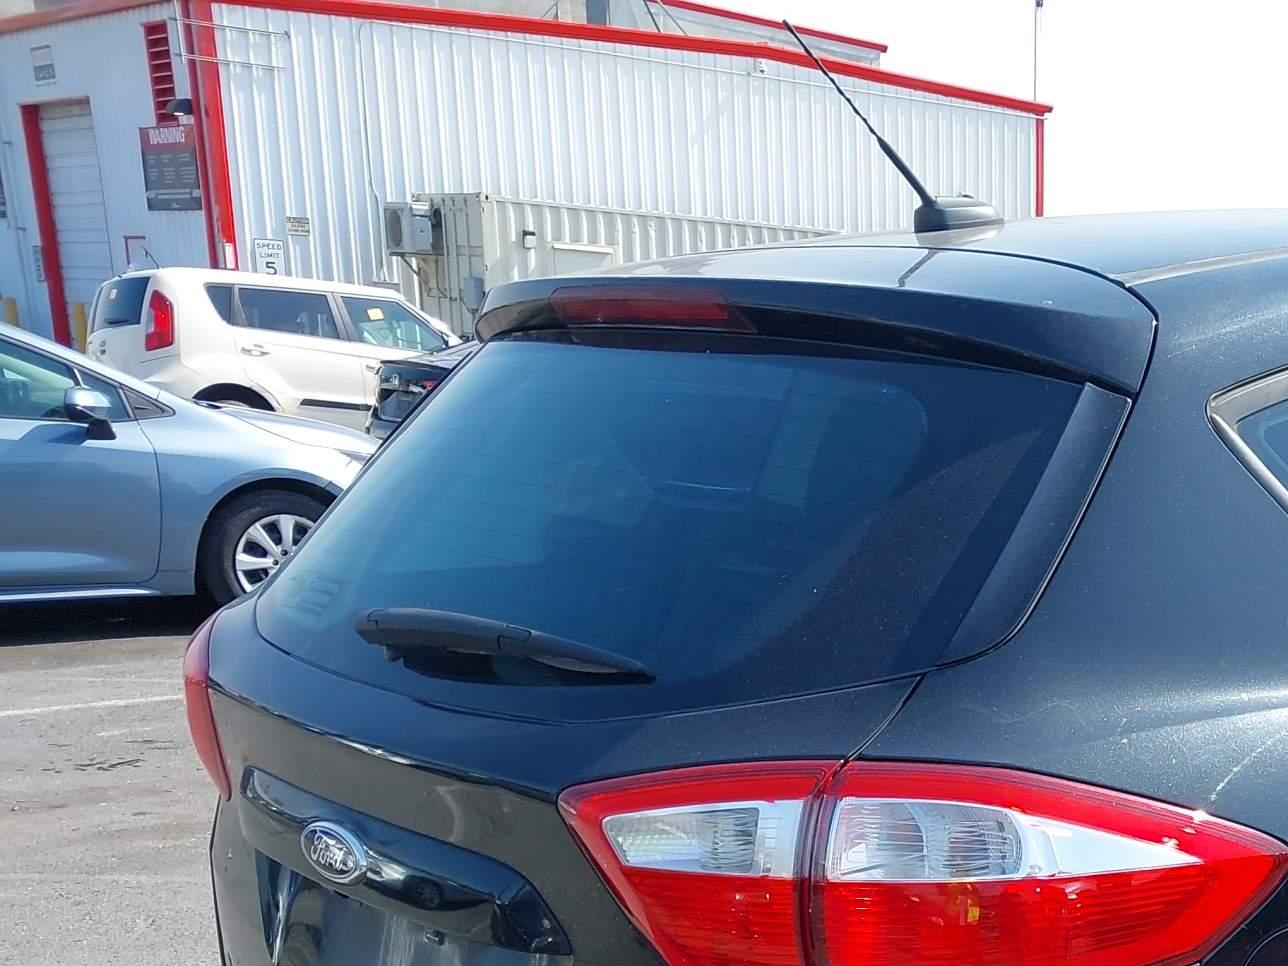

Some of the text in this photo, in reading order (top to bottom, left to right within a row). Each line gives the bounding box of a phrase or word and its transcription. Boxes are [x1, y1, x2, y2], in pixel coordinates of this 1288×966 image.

[149, 126, 185, 145] WARNING
[257, 242, 282, 251] SPEED
[260, 251, 280, 259] LIMIT
[265, 261, 278, 275] 5
[311, 833, 353, 870] Ford
